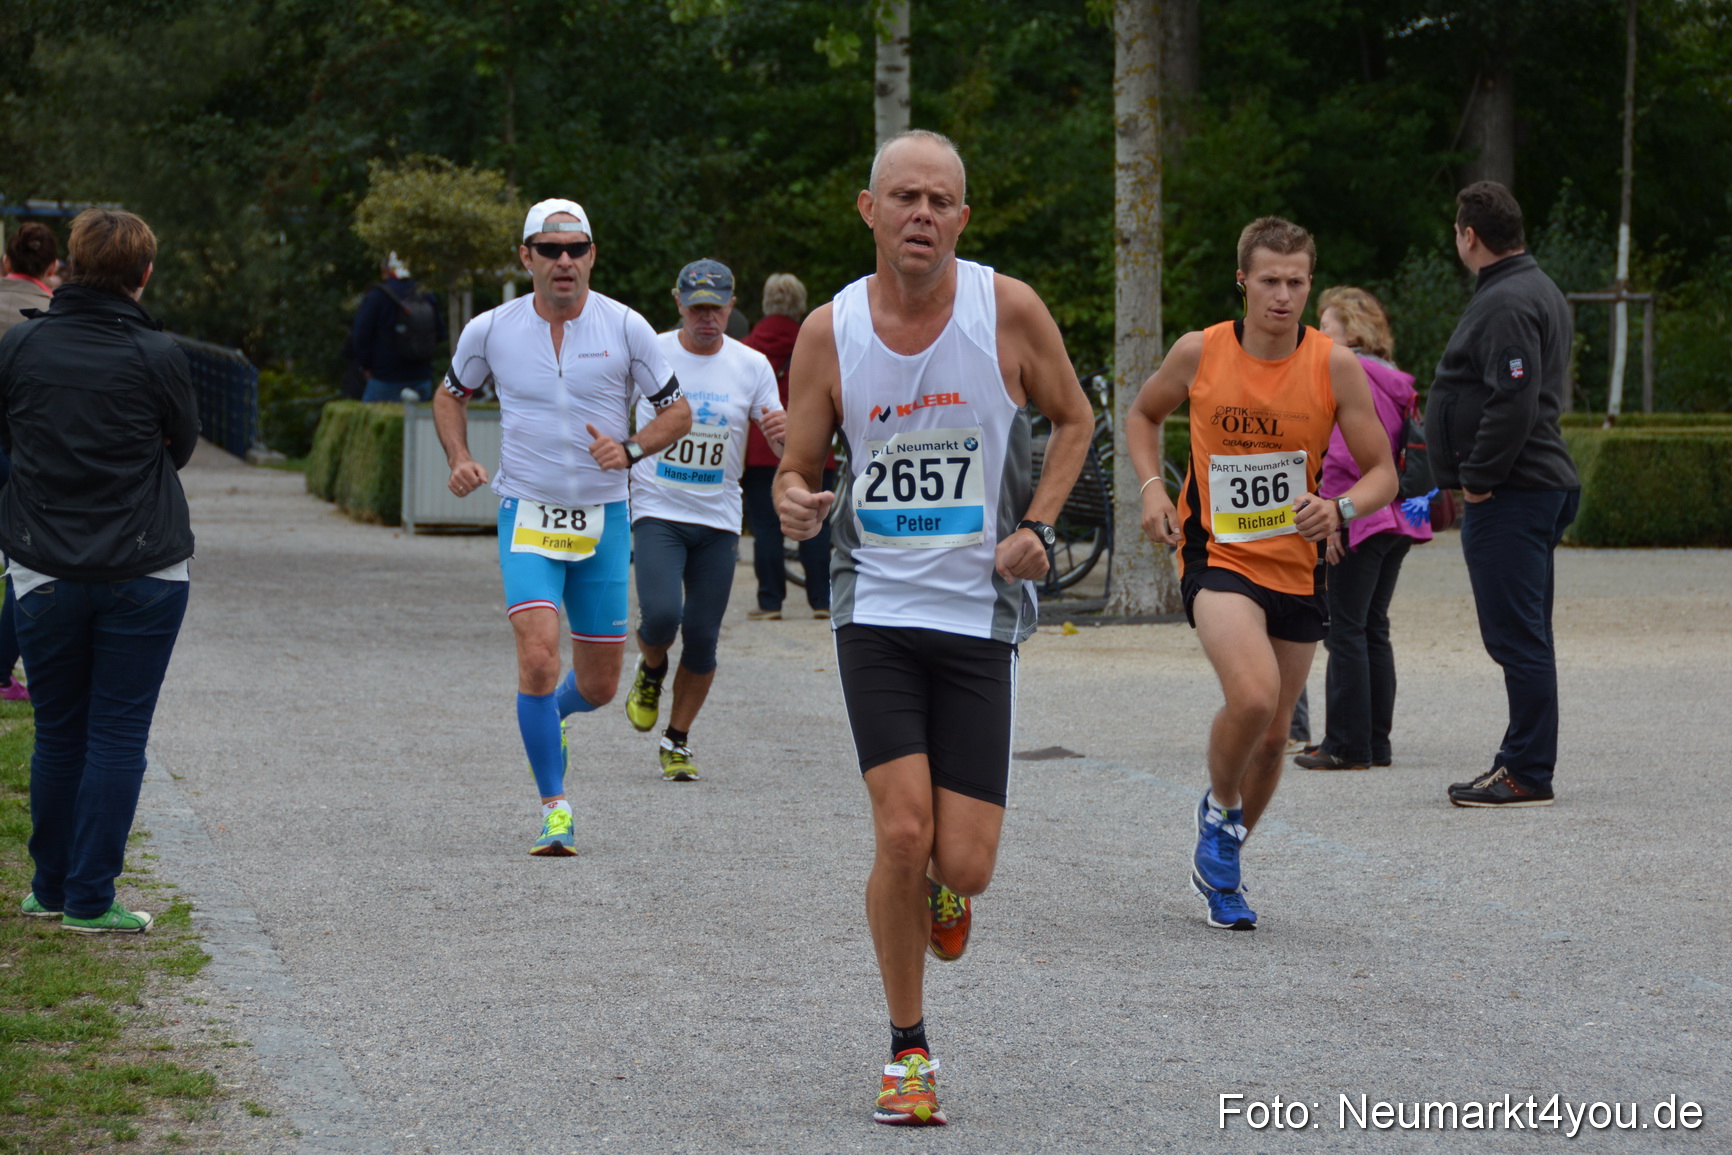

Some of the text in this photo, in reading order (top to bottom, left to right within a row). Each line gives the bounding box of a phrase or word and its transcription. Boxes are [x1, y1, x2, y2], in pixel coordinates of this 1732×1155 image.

[896, 392, 968, 417] KLEBL
[1222, 415, 1284, 437] OEXL
[664, 439, 724, 466] 2018
[897, 440, 959, 454] Neumarkt
[664, 467, 716, 483] Hans-Peter
[1211, 459, 1290, 473] PARTL Neumarkt
[865, 457, 971, 503] 2657
[1230, 472, 1290, 509] 366
[538, 505, 587, 531] 128
[896, 514, 941, 532] Peter
[1238, 512, 1286, 529] Richard
[542, 536, 573, 549] Frank
